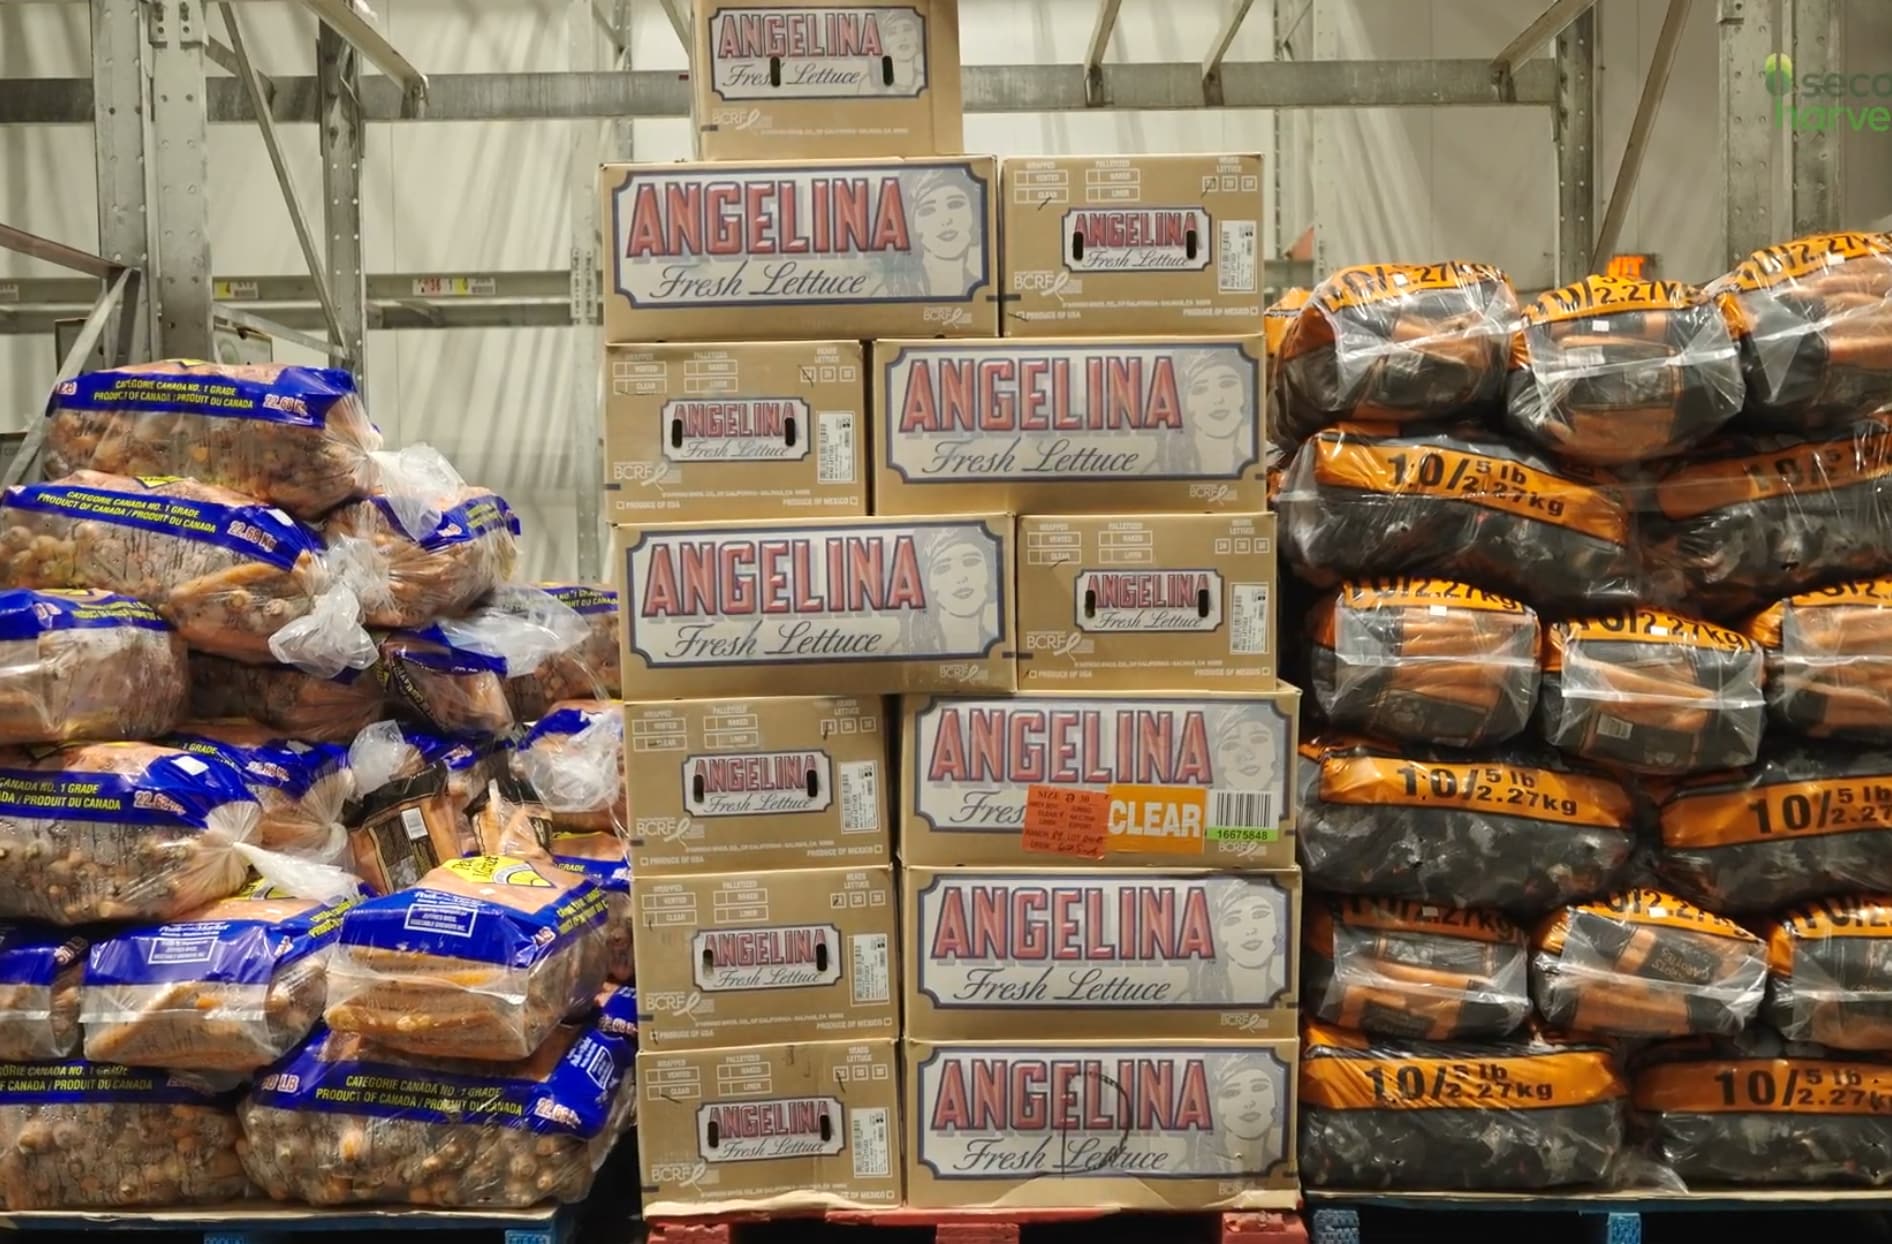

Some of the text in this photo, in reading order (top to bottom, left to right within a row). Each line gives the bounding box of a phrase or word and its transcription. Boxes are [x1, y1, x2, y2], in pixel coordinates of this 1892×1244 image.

[717, 12, 883, 60] ANGELINA
[722, 60, 861, 88] Fres Lettuce
[627, 178, 911, 258] ANGELINA
[1073, 212, 1200, 248] ANGELINA
[1083, 249, 1130, 268] Fresh
[649, 260, 868, 299] Fresh Lettuce
[1014, 275, 1053, 290] BCRF
[210, 385, 237, 395] GRADE
[210, 396, 222, 406] DU
[223, 397, 253, 408] CANADA
[899, 356, 1182, 432] ANGELINA
[673, 402, 796, 438] ANGELINA
[681, 440, 728, 458] Fresh
[921, 437, 1140, 474] Fresh Lettuce
[613, 466, 652, 480] BCRF
[1387, 452, 1471, 490] 10/
[1475, 460, 1527, 485] 5 lb
[1463, 475, 1565, 517] 2.27kg
[37, 493, 79, 510] PRODUCT
[79, 502, 91, 513] OF
[93, 503, 126, 517] CANADA
[131, 508, 169, 523] PRODUIT
[170, 515, 183, 526] DU
[183, 516, 217, 533] CANADA
[164, 502, 169, 513] 1
[171, 504, 200, 519] GRADE
[641, 535, 927, 618] ANGELINA
[1087, 574, 1210, 609] ANGELINA
[1093, 610, 1144, 628] Fresh
[665, 620, 883, 658] Fresh Lettuce
[1026, 635, 1065, 649] BCRF
[188, 743, 218, 755] GRADE
[927, 707, 1214, 784] ANGELINA
[694, 755, 817, 793] ANGELINA
[1397, 767, 1478, 800] 10/
[1485, 768, 1535, 788] 5 lb
[60, 783, 66, 794] 1
[67, 783, 99, 795] GRADE
[1476, 785, 1577, 816] 2.27kg
[1837, 788, 1854, 804] 5
[23, 795, 67, 807] PRODUIT
[67, 797, 82, 809] DU
[83, 796, 121, 811] CANADA
[703, 794, 752, 814] Fresh
[949, 790, 1025, 825] Fres
[1748, 789, 1832, 834] 10/
[636, 822, 676, 837] BCRF
[1107, 799, 1201, 838] CLEAR
[1217, 829, 1269, 841] 16675848
[930, 886, 1215, 961] ANGELINA
[704, 929, 827, 967] ANGELINA
[713, 968, 763, 988] Fresh
[953, 966, 1172, 1000] Fresh Lettuce
[646, 996, 685, 1010] BCRF
[8, 1079, 45, 1092] CANADA
[54, 1079, 96, 1091] PRODUIT
[98, 1079, 111, 1090] DU
[278, 1073, 300, 1093] LB
[345, 1075, 398, 1091] CATEGORIE
[400, 1080, 438, 1094] CANADA
[1364, 1065, 1447, 1101] 10/
[1453, 1063, 1508, 1082] 5 lb
[1805, 1068, 1823, 1085] 5
[315, 1088, 362, 1102] PRODUCT
[364, 1089, 377, 1101] OF
[379, 1093, 417, 1108] CANADA
[930, 1059, 1214, 1131] ANGELINA
[1445, 1082, 1553, 1100] 2.27kg
[1714, 1069, 1799, 1107] 10/
[708, 1101, 831, 1140] ANGELINA
[718, 1139, 765, 1158] Fresh
[953, 1136, 1170, 1171] Fresh Lettuce
[651, 1168, 691, 1182] BCRF
